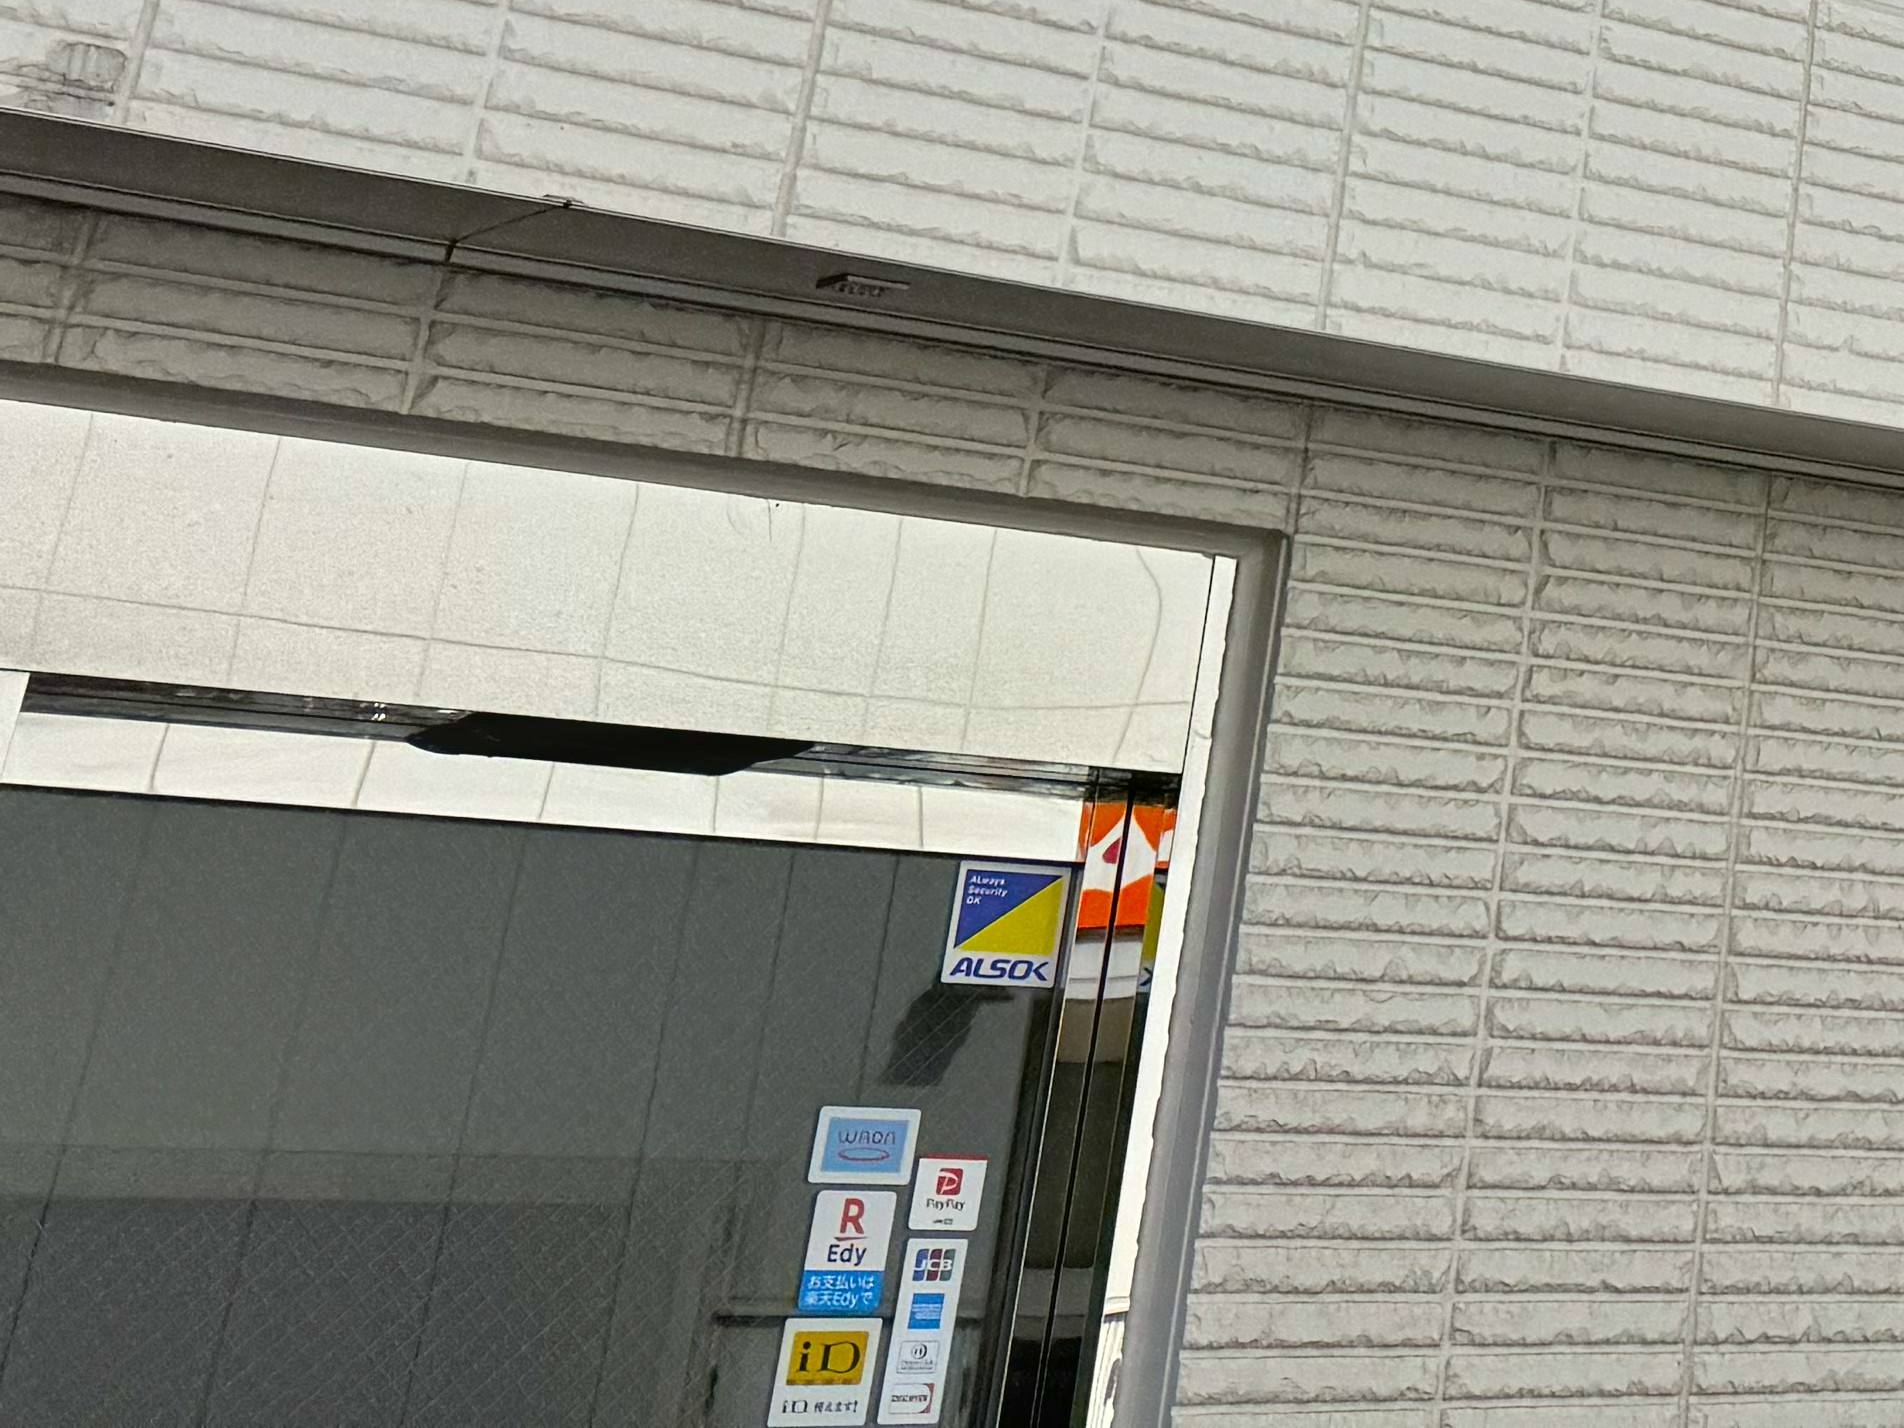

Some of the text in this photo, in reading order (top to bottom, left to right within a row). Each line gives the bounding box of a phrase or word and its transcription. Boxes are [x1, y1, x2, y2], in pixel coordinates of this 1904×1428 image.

[950, 957, 1049, 981] ALSOK
[840, 1198, 865, 1234] R
[827, 1244, 867, 1266] Edy
[915, 1258, 952, 1270] JCB
[808, 1275, 874, 1290] お支払いは
[796, 1341, 860, 1374] iD
